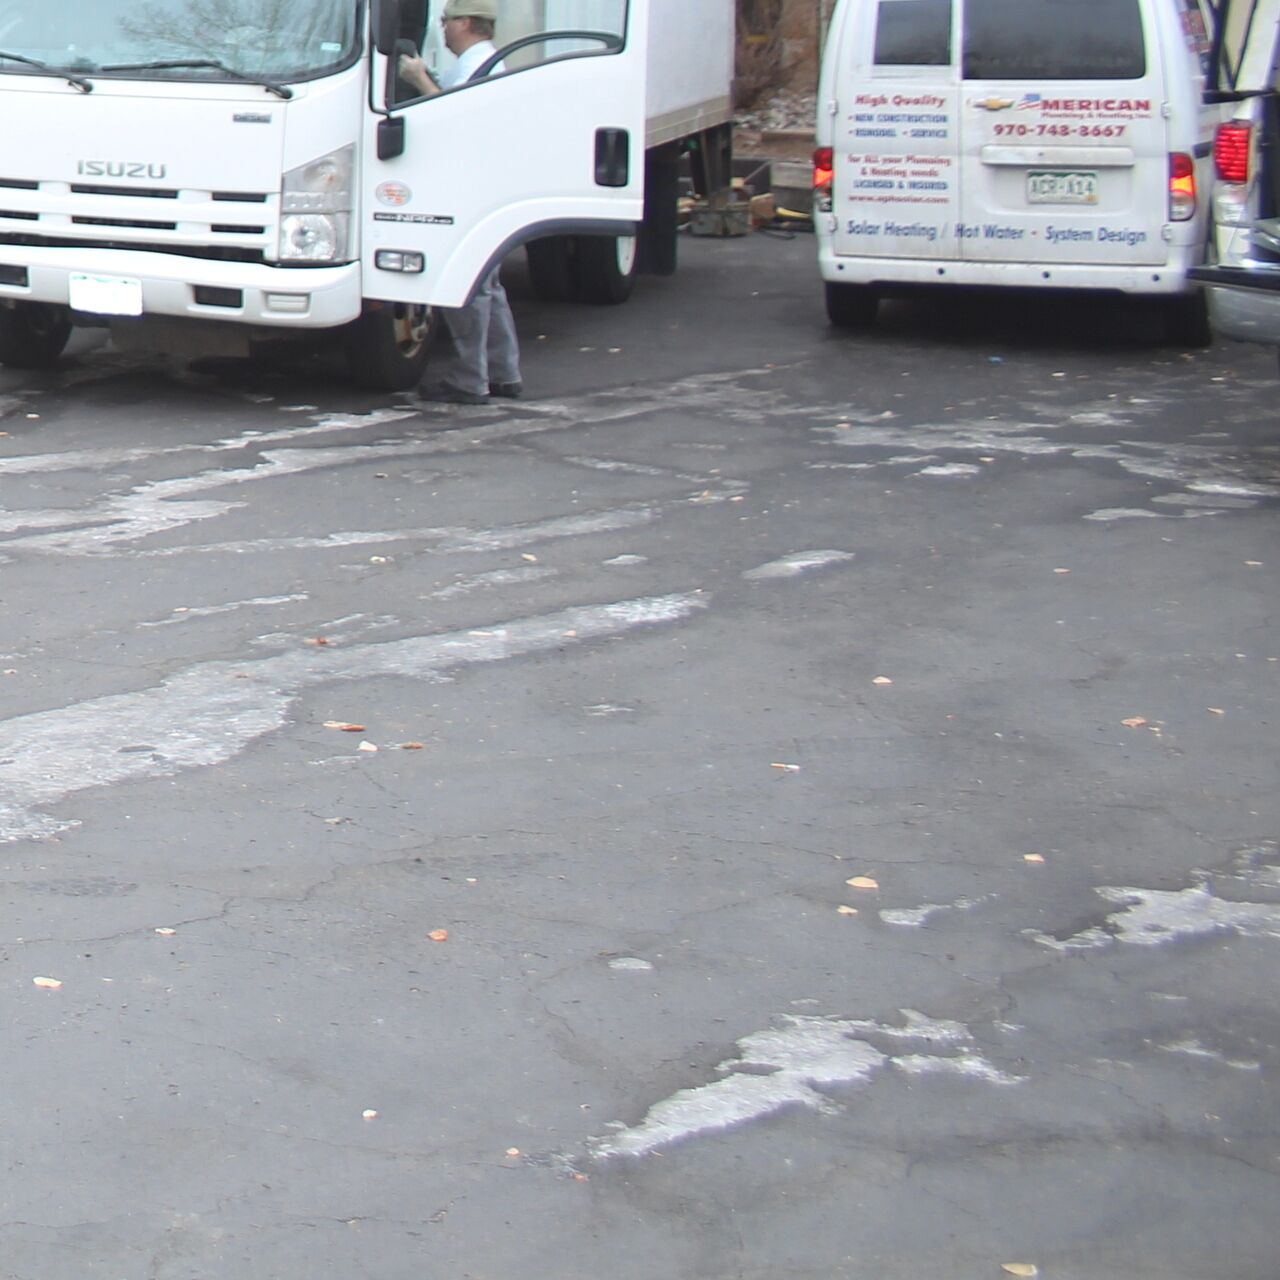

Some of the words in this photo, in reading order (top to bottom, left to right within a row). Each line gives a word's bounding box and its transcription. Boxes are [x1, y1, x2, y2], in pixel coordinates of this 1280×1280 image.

[854, 95, 888, 107] High
[892, 95, 946, 108] Quality
[77, 160, 166, 180] ISUZU
[846, 220, 880, 236] Solar
[884, 221, 937, 240] Heating
[954, 224, 979, 238] Hot
[984, 224, 1024, 240] Water
[1044, 226, 1092, 244] System
[1098, 227, 1147, 246] Design
